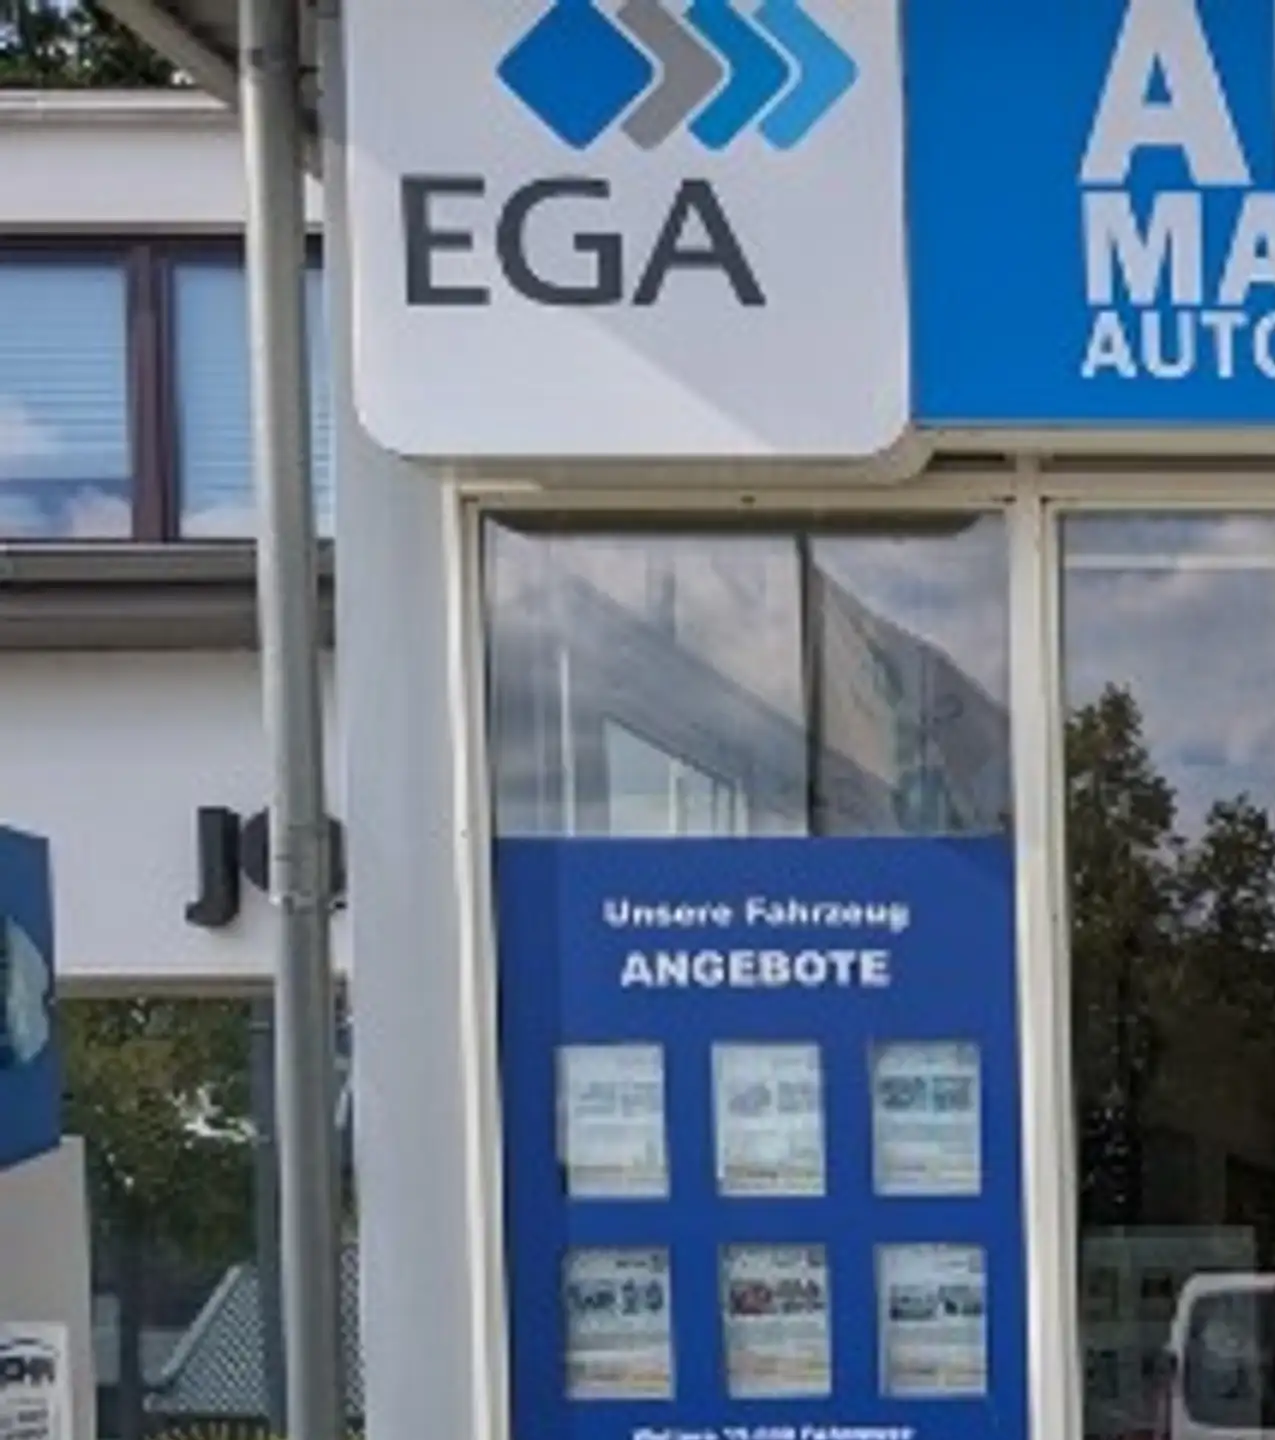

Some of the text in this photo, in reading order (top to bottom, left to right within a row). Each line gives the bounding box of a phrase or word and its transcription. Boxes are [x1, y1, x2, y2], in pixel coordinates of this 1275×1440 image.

[402, 175, 766, 306] EGA
[603, 897, 909, 933] Unsere Fahrzeug
[620, 950, 890, 987] ANGEBOTE
